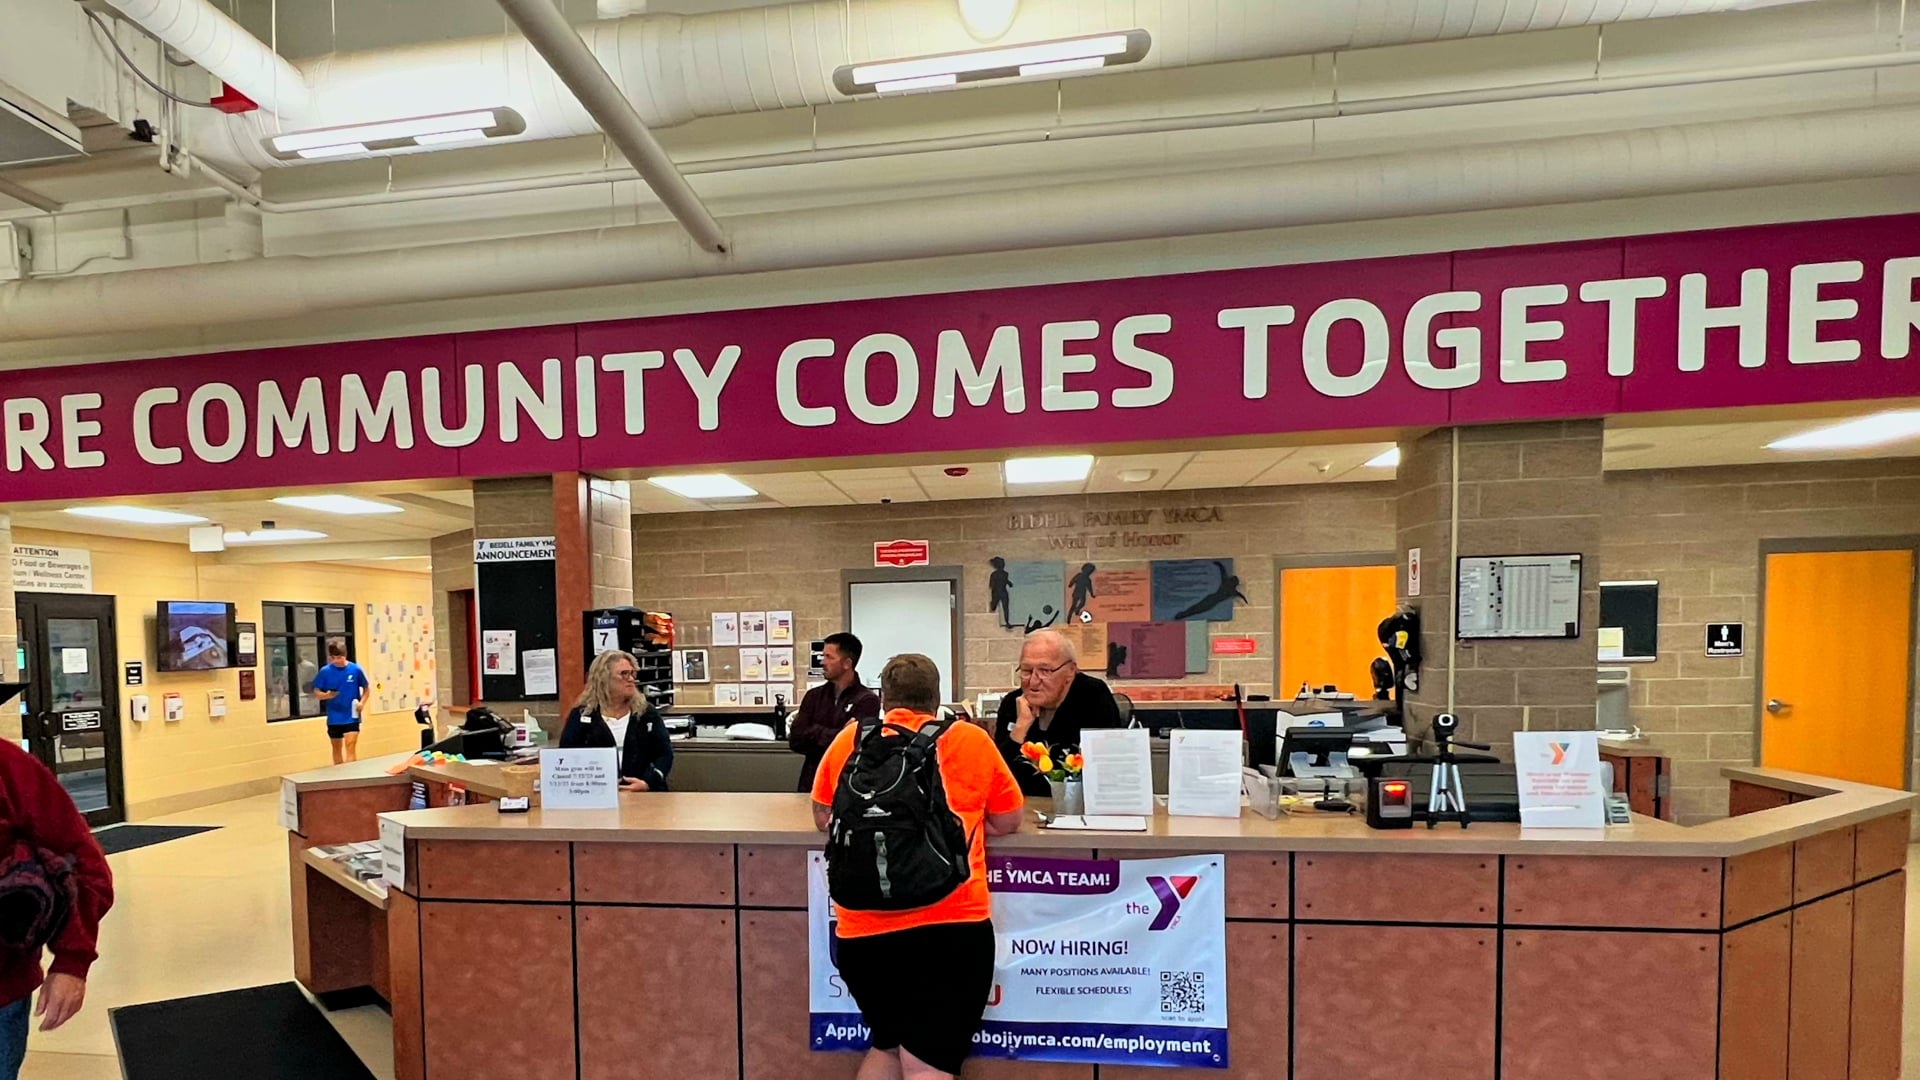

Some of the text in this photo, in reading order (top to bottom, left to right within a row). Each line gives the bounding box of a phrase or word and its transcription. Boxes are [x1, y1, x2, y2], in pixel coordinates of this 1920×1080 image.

[5, 392, 105, 472] RE
[132, 344, 742, 466] COMMUNITY
[775, 313, 1175, 427] COMES
[1084, 509, 1153, 527] FAMILY
[1162, 506, 1224, 524] YMCA
[489, 541, 514, 549] BEDELL
[515, 540, 540, 548] FAMILY
[1048, 531, 1186, 550] Wall of Honor
[13, 546, 60, 557] ATTENTION
[19, 559, 37, 568] Food
[47, 560, 82, 571] Beverages
[33, 570, 63, 579] Wellness
[599, 632, 609, 647] 7
[1006, 869, 1054, 885] YMCA
[1057, 872, 1111, 886] TEAM!
[1126, 902, 1150, 915] the
[1011, 939, 1129, 956] NOW HIRING!
[1020, 966, 1151, 976] MANY POSITIONS AVAILABLE!
[1035, 985, 1132, 995] FLEXIBLE SCHEDULES!
[825, 1022, 1212, 1056] Apply obojiymca.com/employment
